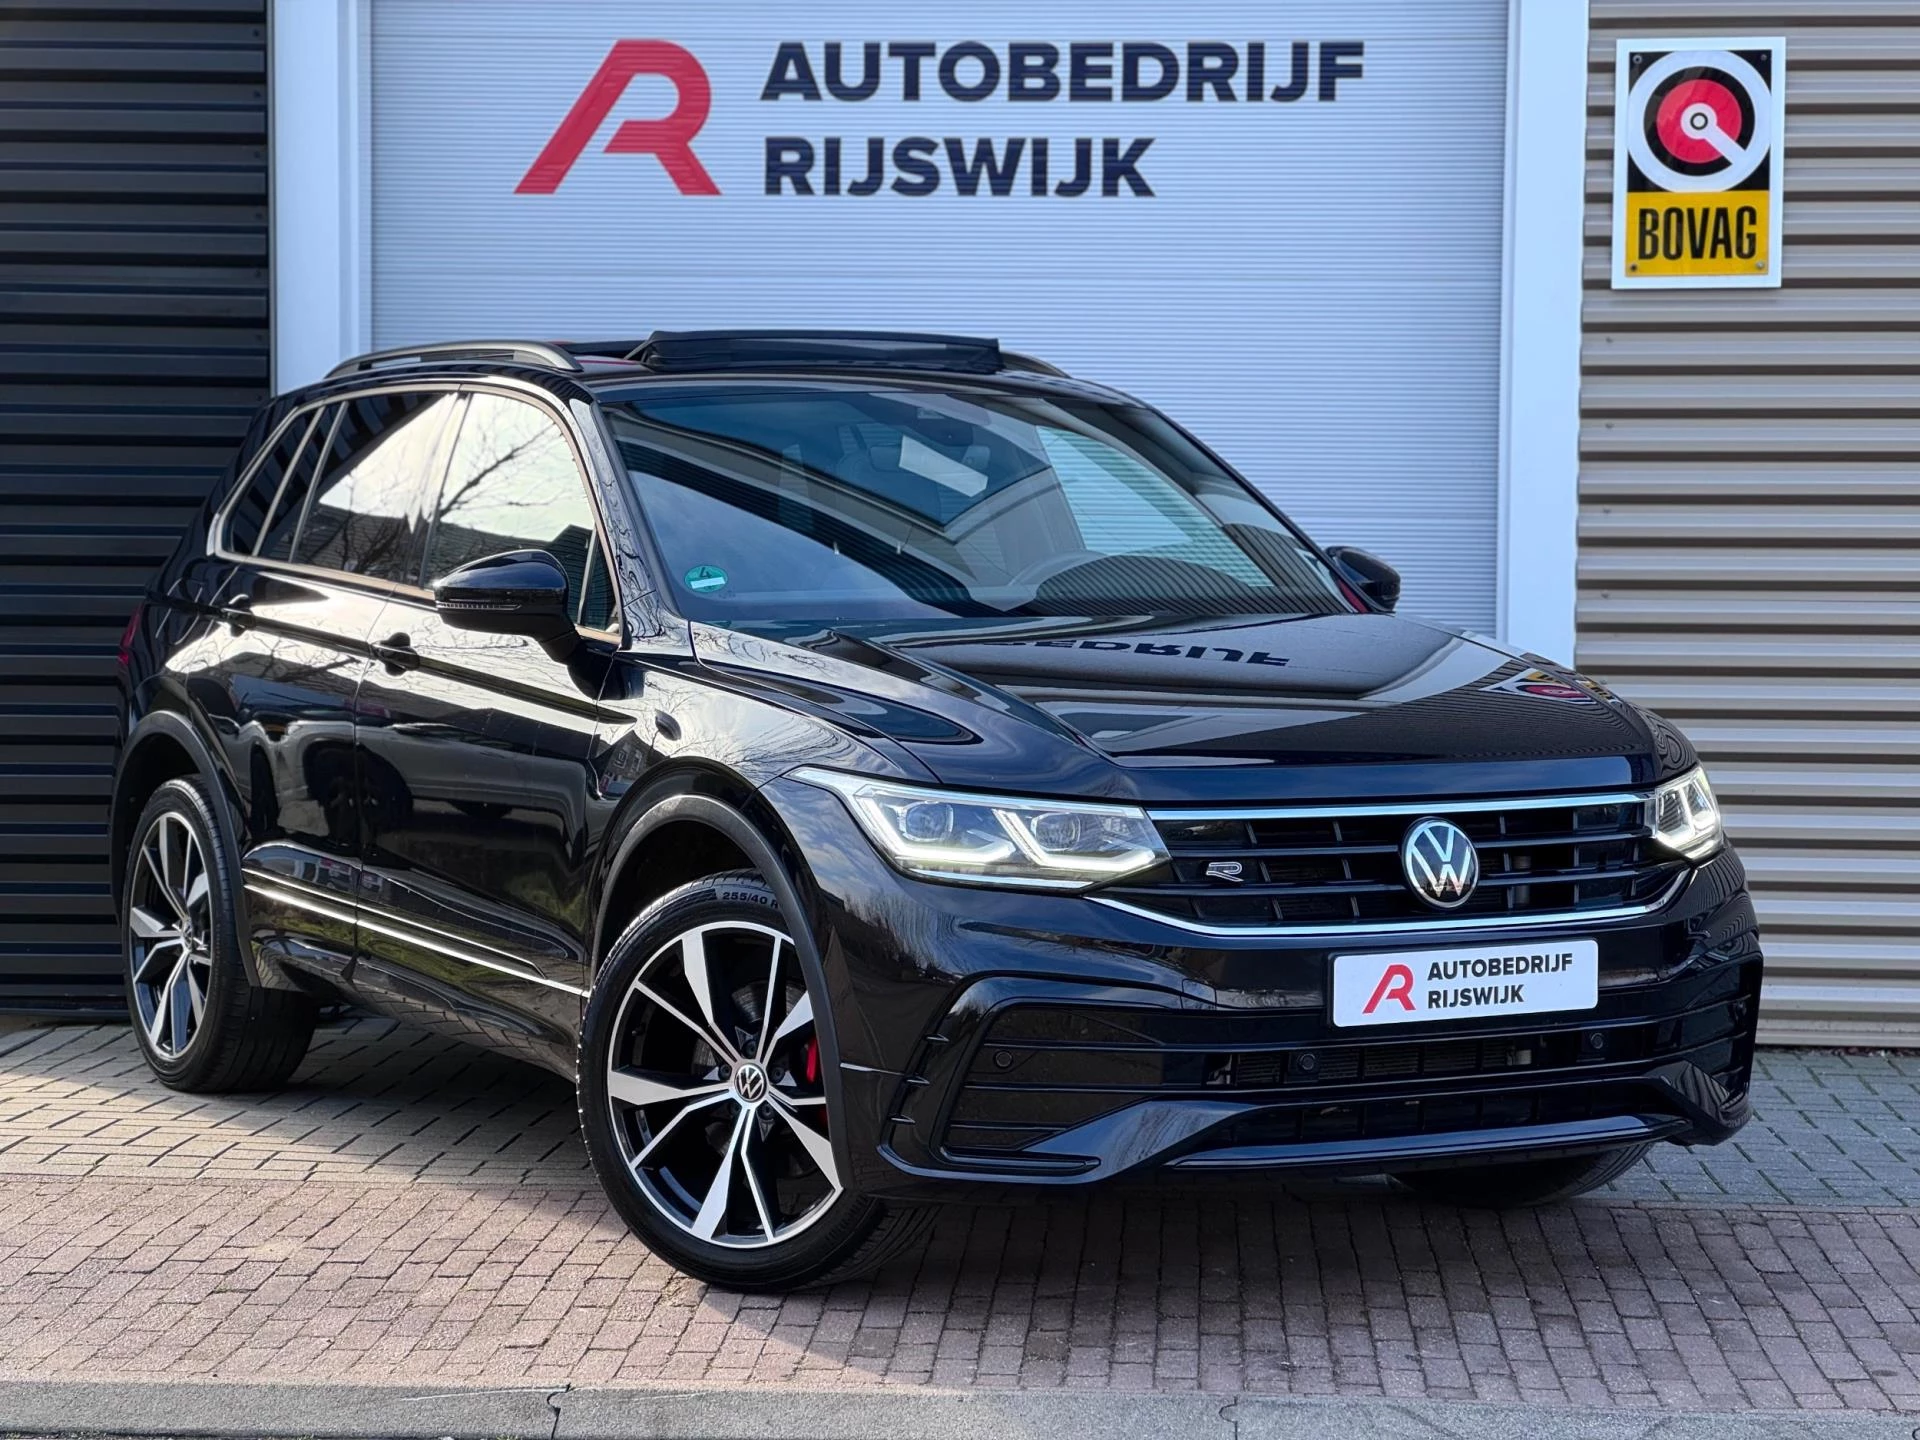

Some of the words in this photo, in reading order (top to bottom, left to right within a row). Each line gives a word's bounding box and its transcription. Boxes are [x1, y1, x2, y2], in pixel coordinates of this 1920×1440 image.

[761, 40, 1364, 102] AUTOBEDRIJF
[764, 136, 1156, 197] RIJSWIJK
[1637, 205, 1758, 261] BOVAG
[722, 890, 769, 906] 255/40
[1427, 952, 1573, 981] AUTOBEDRIJF
[1427, 984, 1525, 1010] RIJSWIJK
